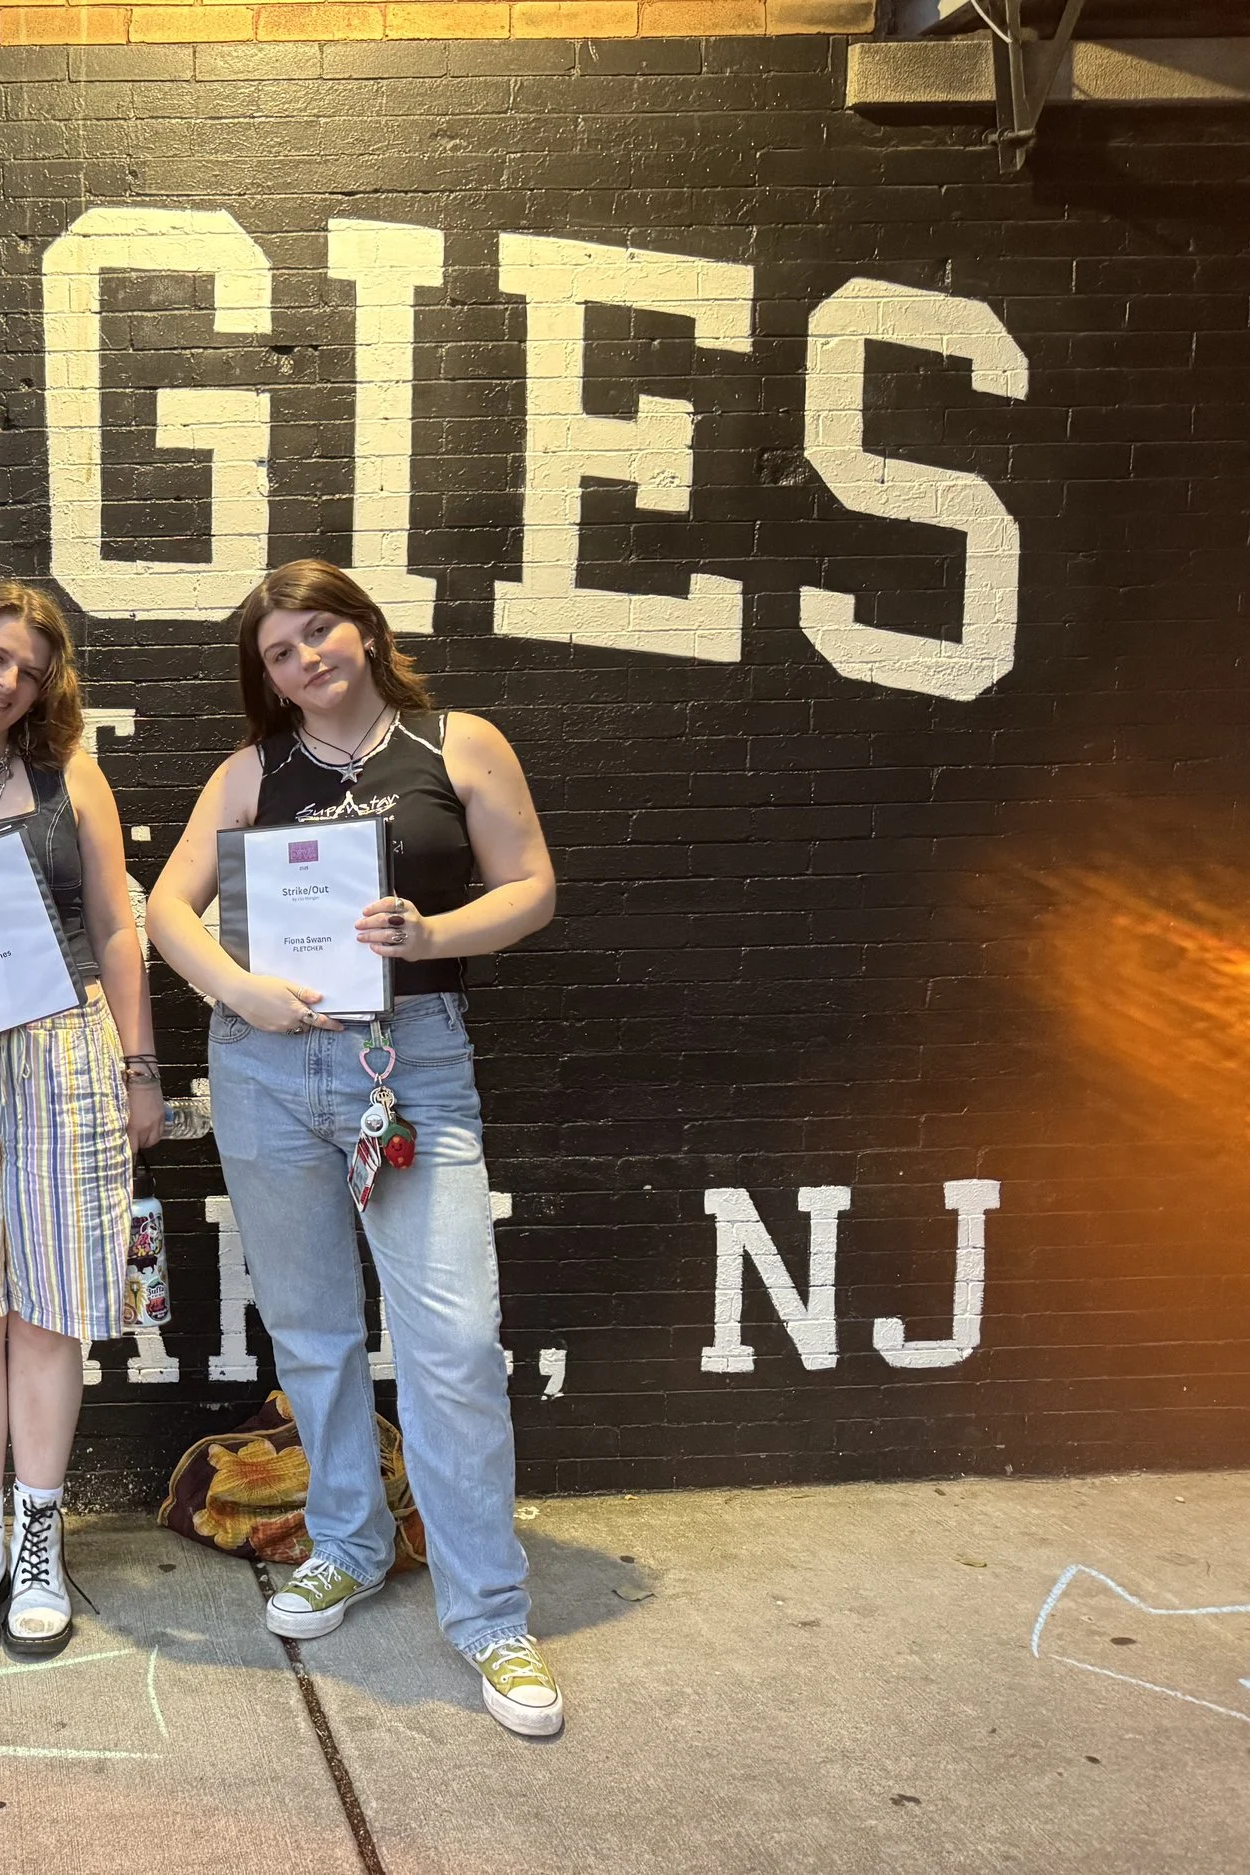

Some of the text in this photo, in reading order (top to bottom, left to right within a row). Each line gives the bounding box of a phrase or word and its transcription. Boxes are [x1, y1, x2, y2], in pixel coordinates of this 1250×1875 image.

[282, 885, 330, 897] Strike/Out
[284, 936, 332, 945] Fiona Swann
[293, 945, 324, 953] FLETCHER
[701, 1178, 1002, 1373] NJ
